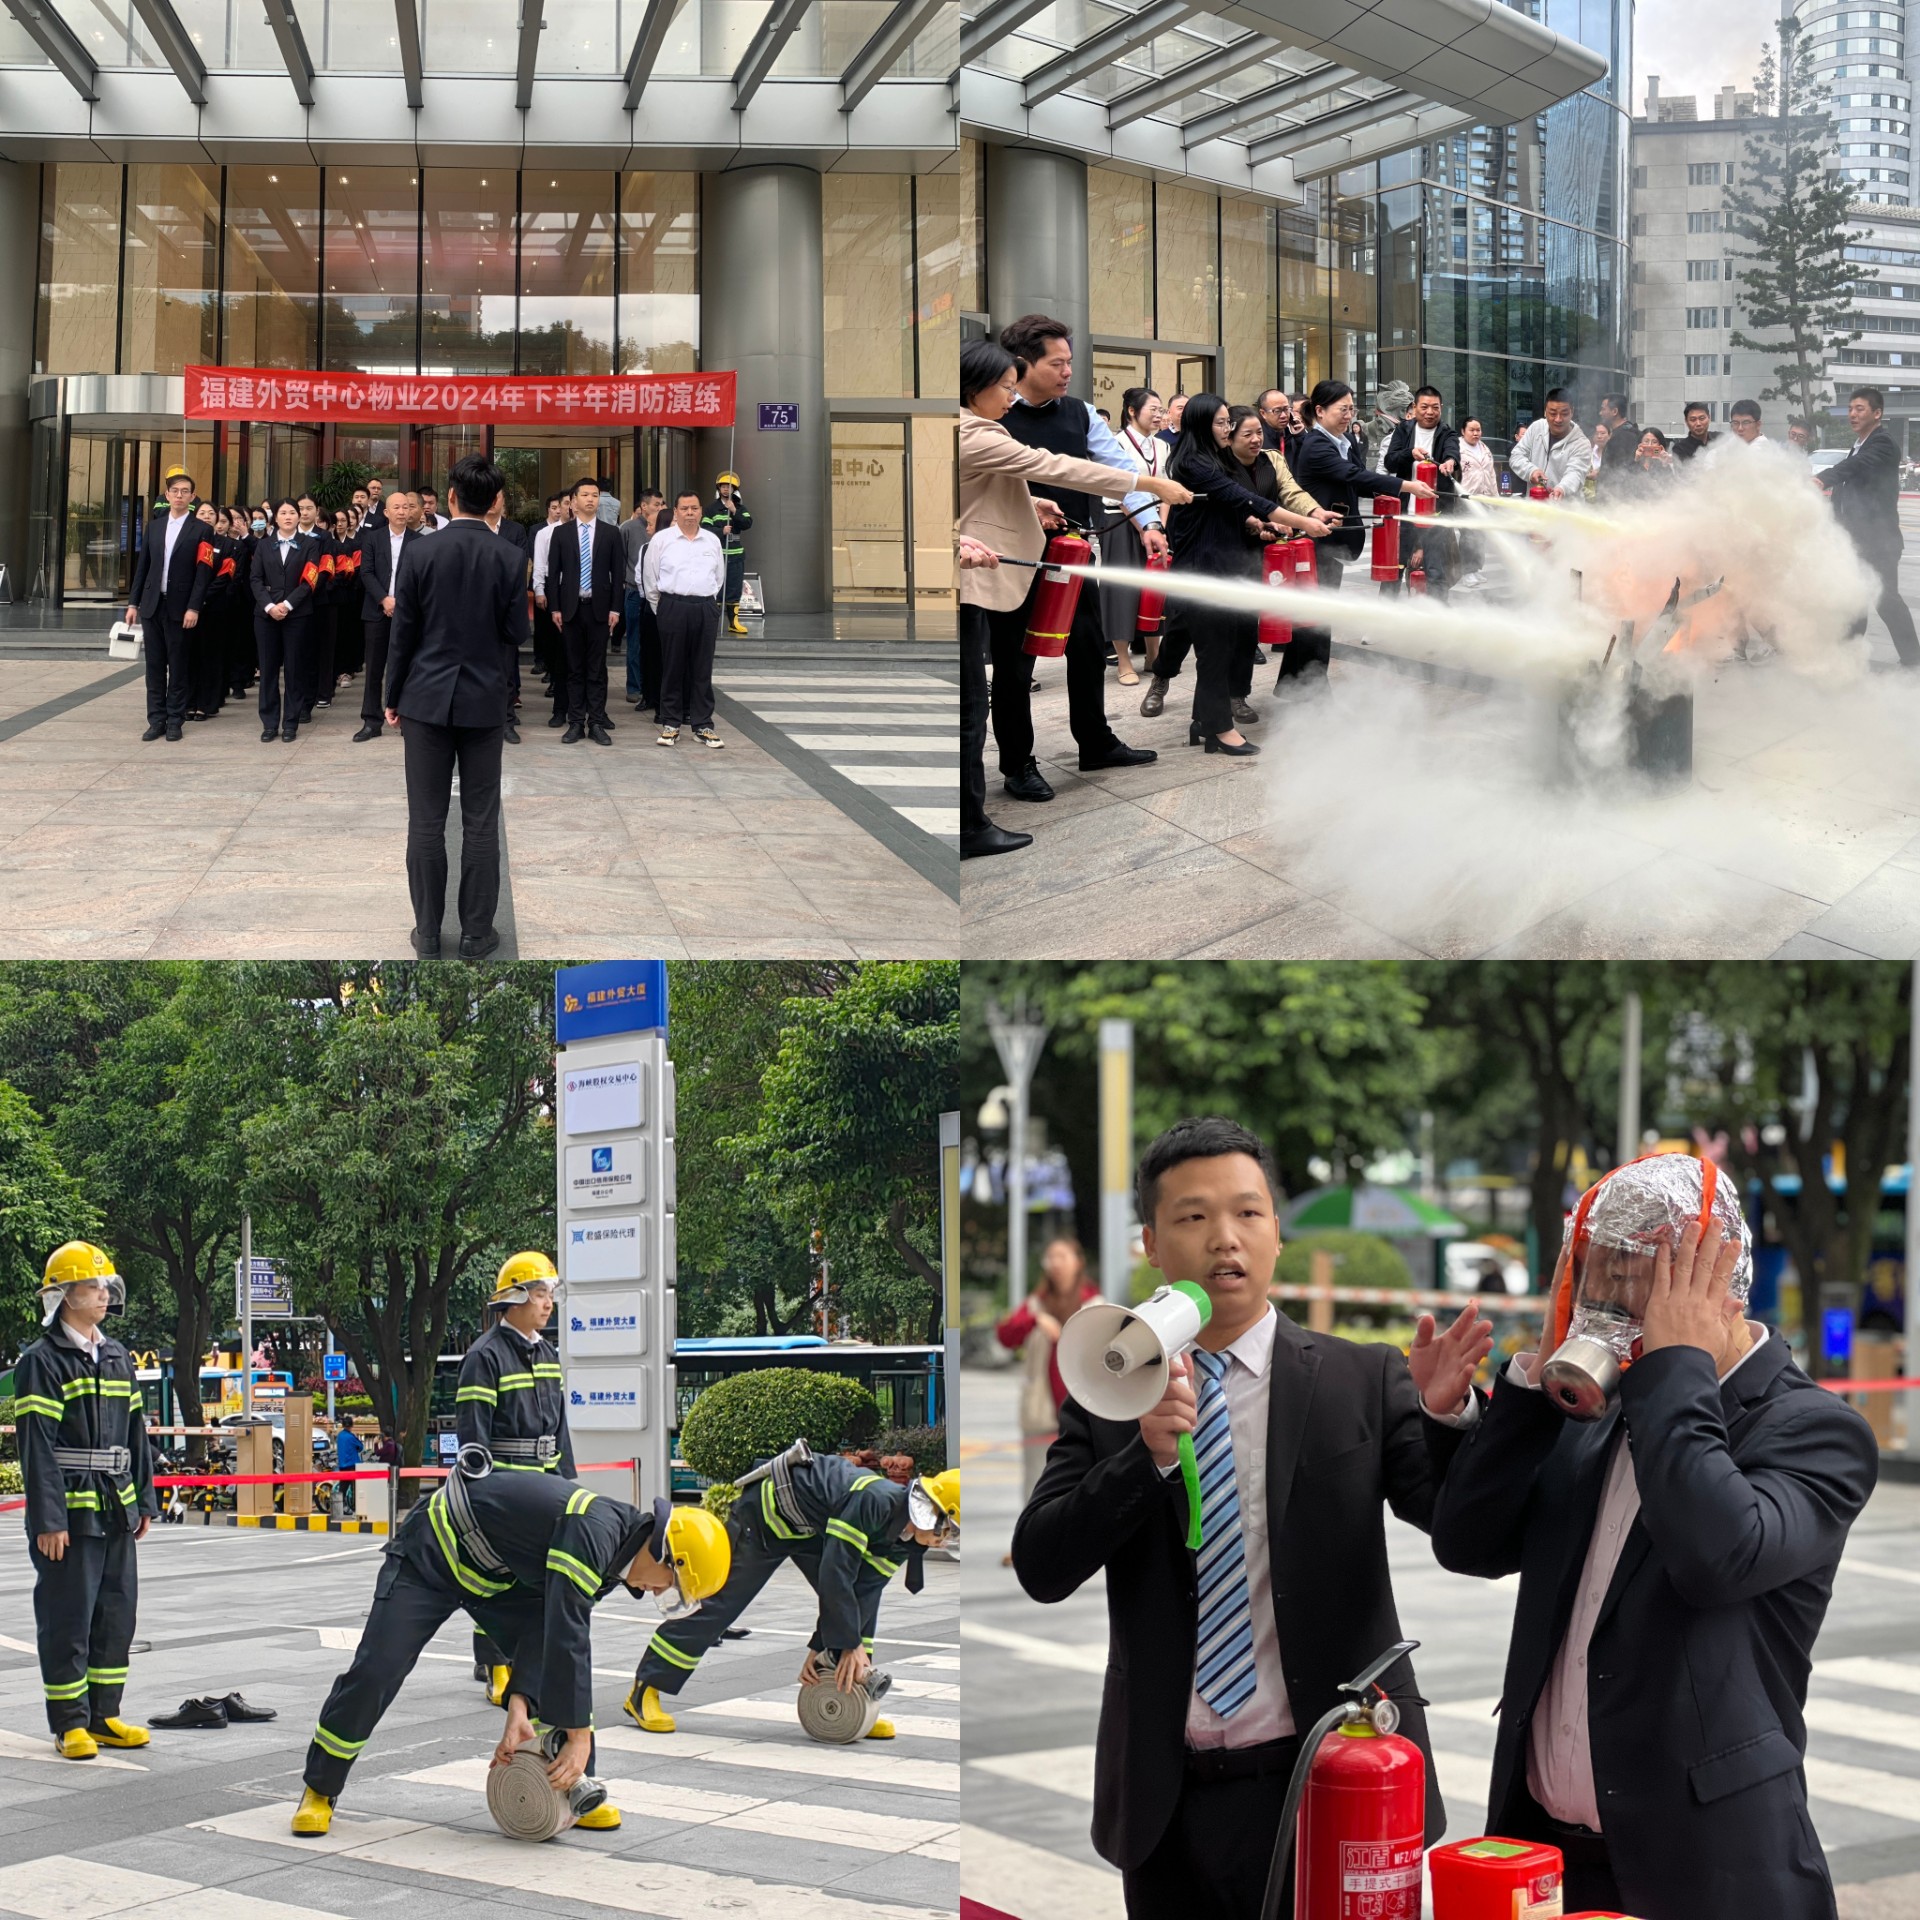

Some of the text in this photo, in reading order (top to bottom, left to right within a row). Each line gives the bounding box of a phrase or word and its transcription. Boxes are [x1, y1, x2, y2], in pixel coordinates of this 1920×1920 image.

[200, 375, 722, 415] 福建外贸中心物业2024年下半年消防演练
[771, 411, 788, 424] 75
[578, 1073, 637, 1088] 海峡股权交易中心
[586, 1228, 635, 1240] 君盛保险代理
[590, 1316, 636, 1326] 福建外贸大厦
[590, 1391, 636, 1401] 福建外贸大厦
